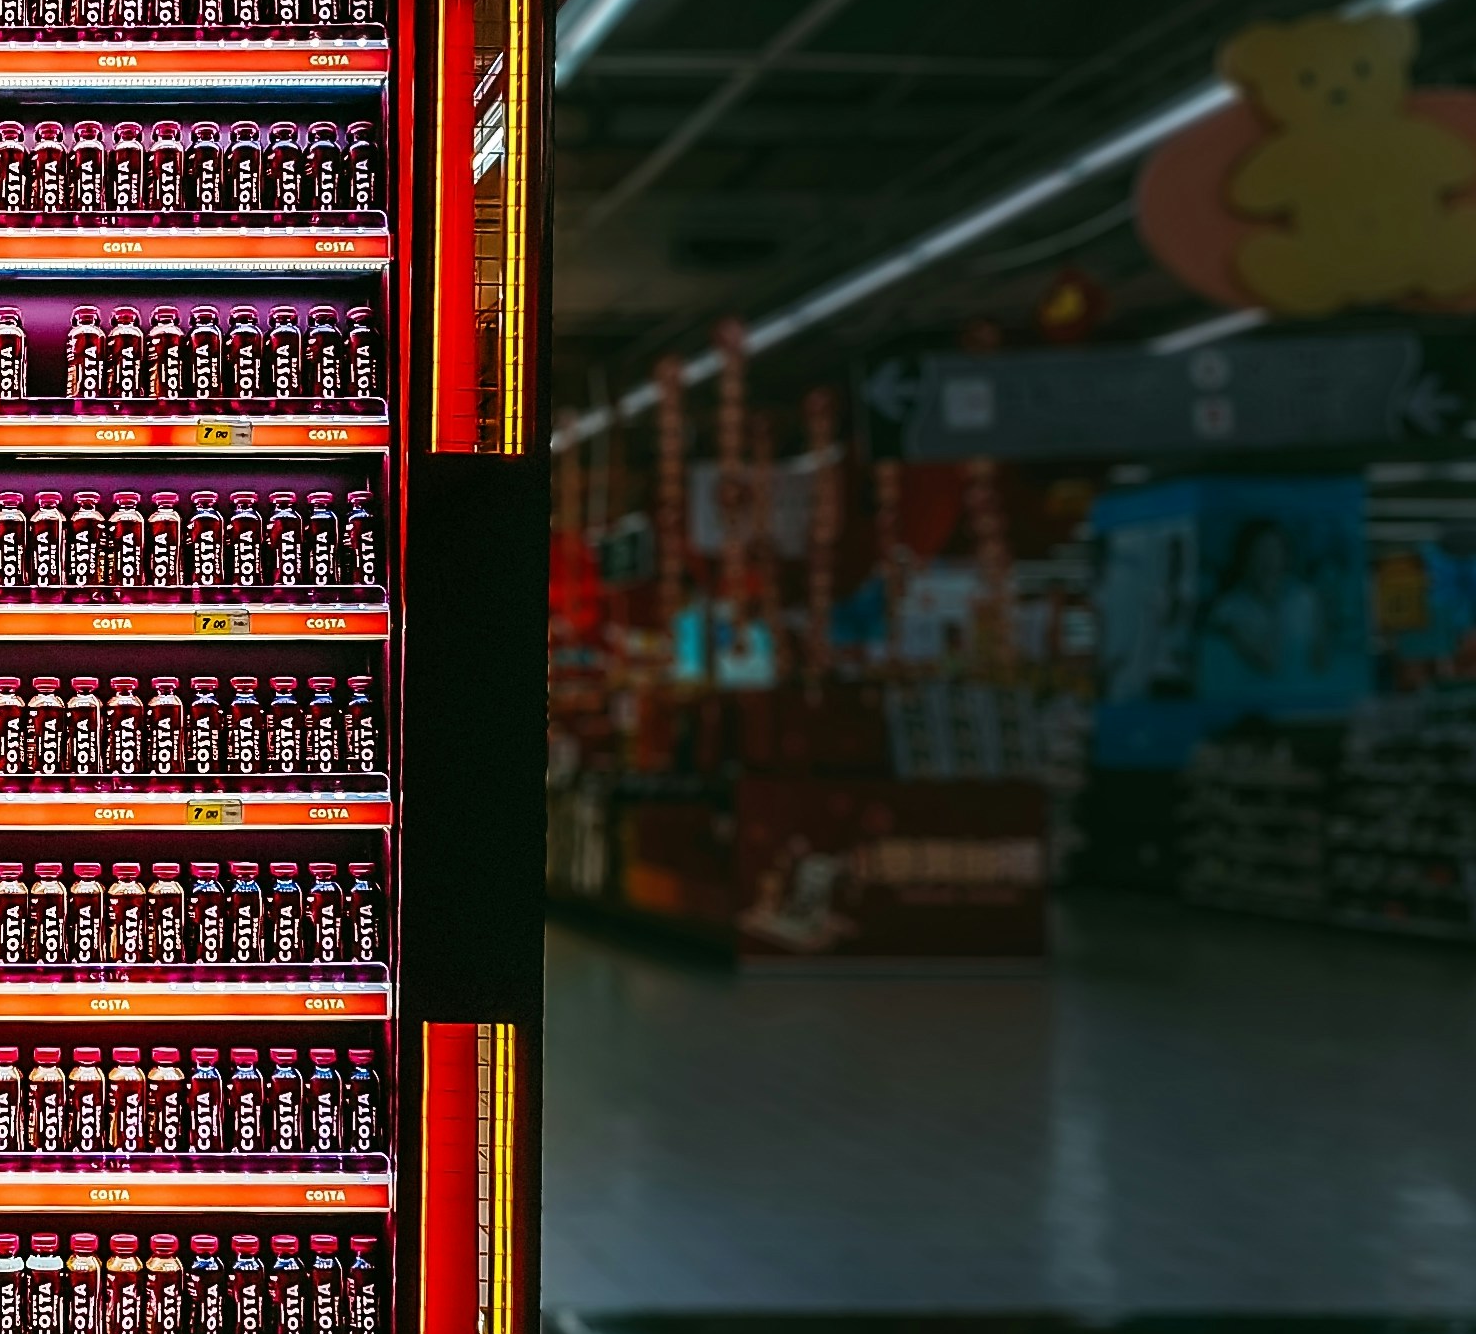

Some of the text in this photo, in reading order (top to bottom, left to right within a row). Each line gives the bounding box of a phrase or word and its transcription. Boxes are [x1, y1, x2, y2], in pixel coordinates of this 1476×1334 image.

[98, 56, 137, 67] COSTA
[310, 55, 349, 67] COSTA
[103, 242, 142, 253] COSTA
[315, 241, 355, 252] COSTA
[96, 430, 135, 441] COSTA
[203, 427, 213, 439] 7
[309, 429, 348, 441] COSTA
[36, 532, 48, 586] COSTA
[75, 531, 88, 586] COSTA
[155, 533, 168, 586] COSTA
[199, 531, 213, 586] COSTA
[240, 531, 254, 585] COSTA
[282, 531, 295, 586] COSTA
[316, 532, 328, 586] COSTA
[93, 617, 132, 629] COSTA
[202, 617, 211, 630] 7
[306, 617, 346, 629] COSTA
[8, 718, 20, 773] COSTA
[122, 717, 134, 773] COSTA
[158, 718, 172, 773] COSTA
[195, 717, 209, 773] COSTA
[239, 717, 252, 773] COSTA
[281, 718, 293, 772] COSTA
[319, 717, 331, 772] COSTA
[95, 808, 134, 819] COSTA
[194, 807, 203, 819] 7
[309, 808, 348, 819] COSTA
[47, 906, 61, 962] COSTA
[126, 907, 140, 962] COSTA
[162, 907, 174, 962] COSTA
[238, 906, 251, 961] COSTA
[279, 906, 293, 961] COSTA
[90, 999, 130, 1010] COSTA
[305, 998, 344, 1010] COSTA
[46, 1094, 60, 1150] COSTA
[81, 1094, 94, 1150] COSTA
[165, 1093, 178, 1150] COSTA
[197, 1093, 211, 1150] COSTA
[241, 1093, 254, 1150] COSTA
[279, 1092, 293, 1149] COSTA
[319, 1093, 332, 1149] COSTA
[90, 1189, 129, 1200] COSTA
[306, 1189, 345, 1201] COSTA
